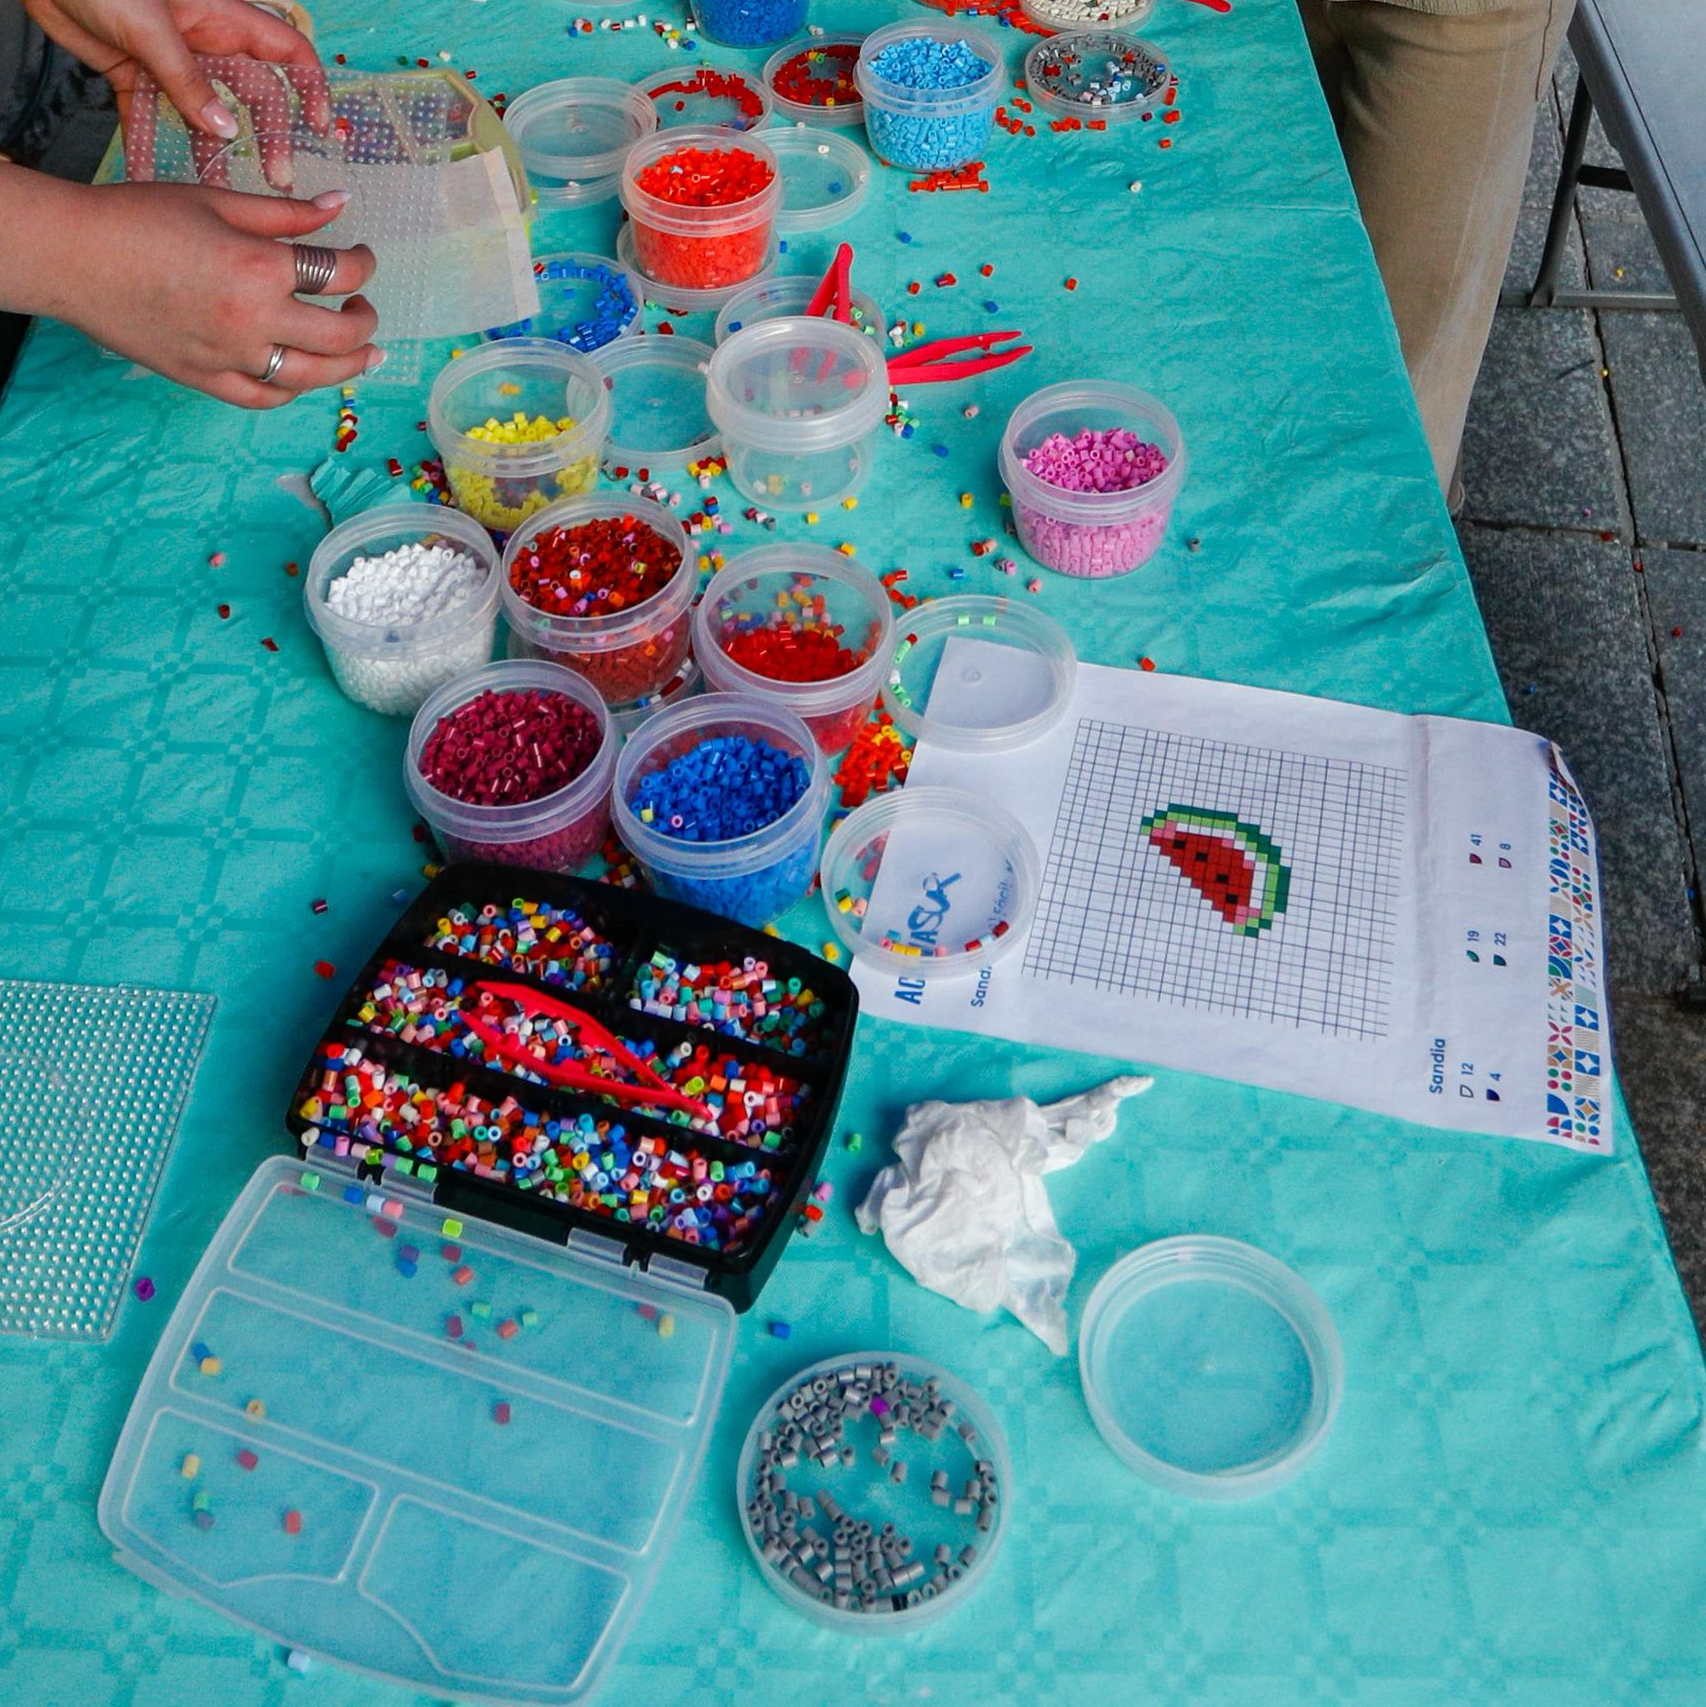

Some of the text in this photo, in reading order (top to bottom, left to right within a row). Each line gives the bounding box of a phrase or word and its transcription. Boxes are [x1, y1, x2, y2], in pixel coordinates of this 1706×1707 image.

[1470, 833, 1483, 847] 41
[1499, 842, 1512, 851] 8
[1467, 929, 1481, 943] 19
[1494, 932, 1507, 947] 22
[1461, 1062, 1475, 1077] 12
[1489, 1072, 1502, 1082] 4
